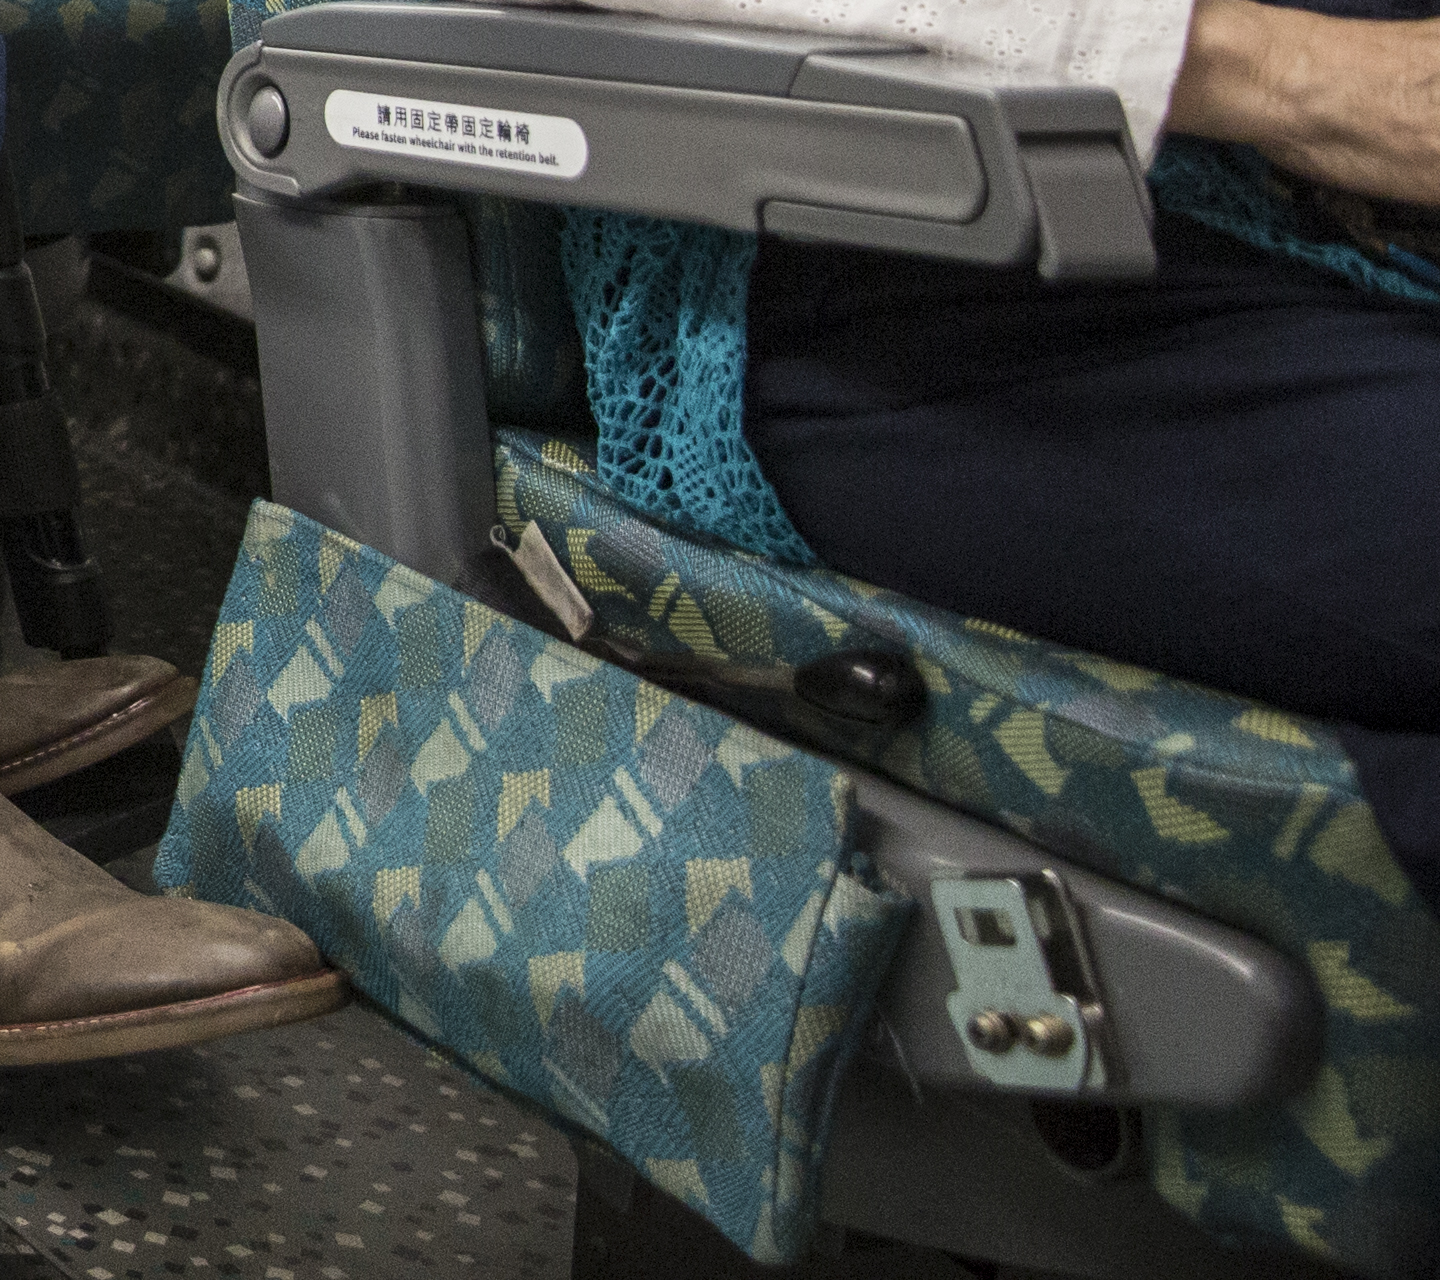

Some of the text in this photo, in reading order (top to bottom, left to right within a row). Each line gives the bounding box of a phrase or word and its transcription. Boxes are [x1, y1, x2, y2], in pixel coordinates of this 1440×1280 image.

[376, 103, 531, 145] 請用固定帶固定輪椅
[352, 126, 380, 142] Please
[381, 129, 407, 144] fasten
[409, 135, 455, 152] wheelchair
[457, 141, 477, 154] with
[479, 144, 494, 157] the
[495, 148, 537, 163] retention
